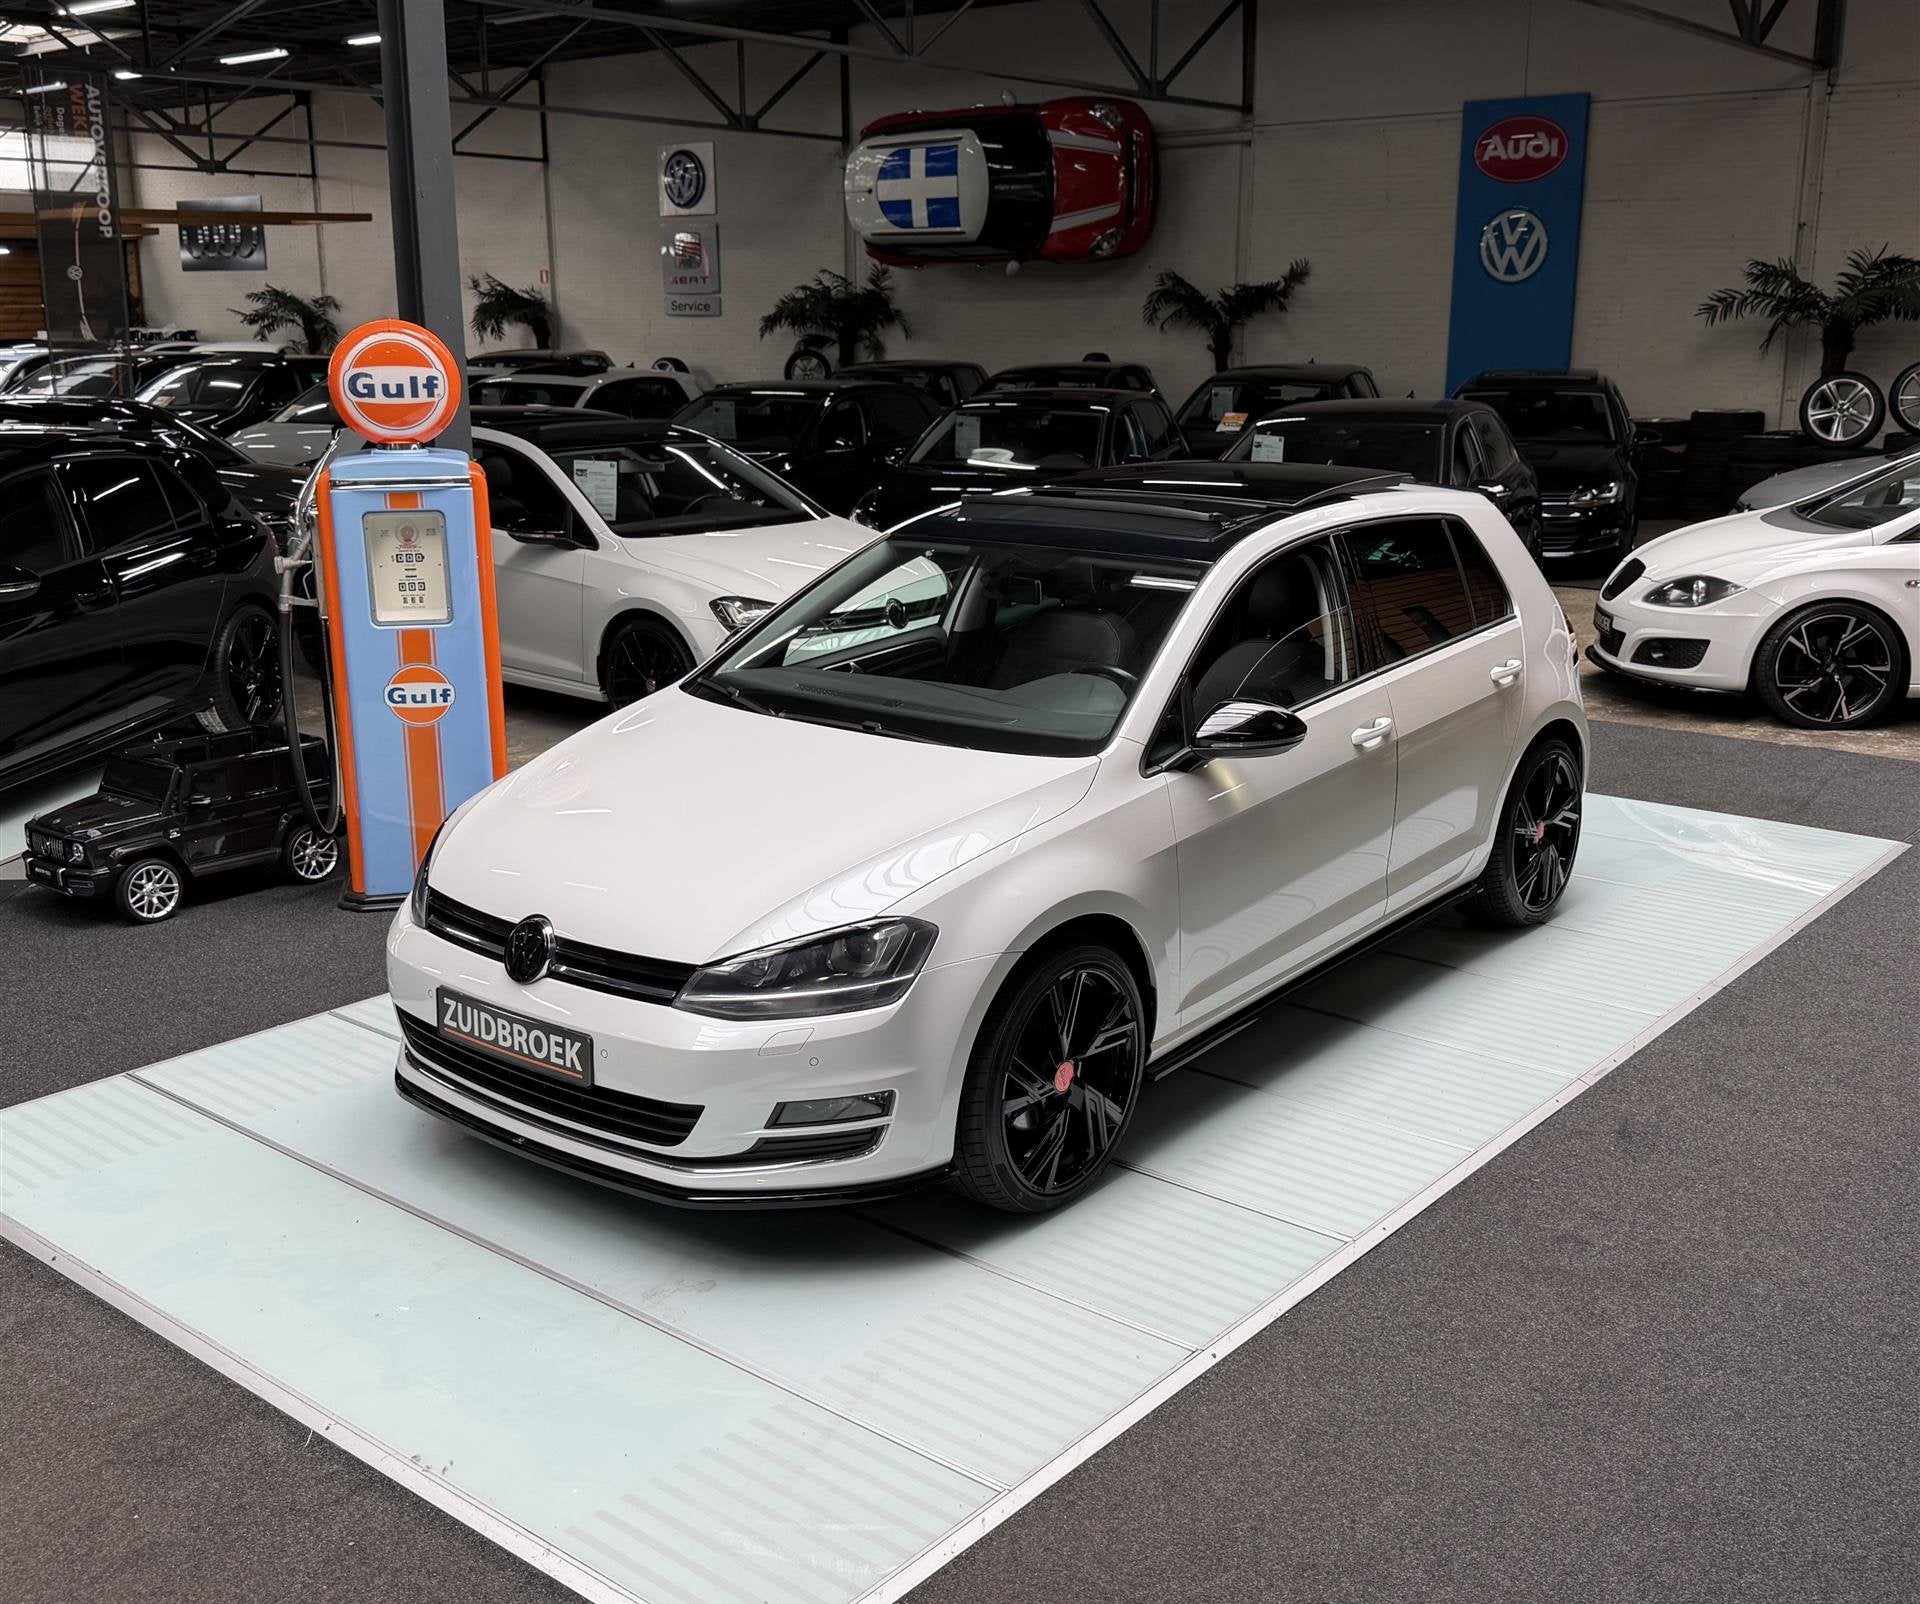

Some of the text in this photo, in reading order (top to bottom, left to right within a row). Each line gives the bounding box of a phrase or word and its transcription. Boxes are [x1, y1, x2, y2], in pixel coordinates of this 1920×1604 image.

[671, 300, 711, 312] Service
[347, 372, 439, 399] Gulf
[387, 687, 452, 705] Gulf
[443, 997, 583, 1072] ZUIDBROEK
